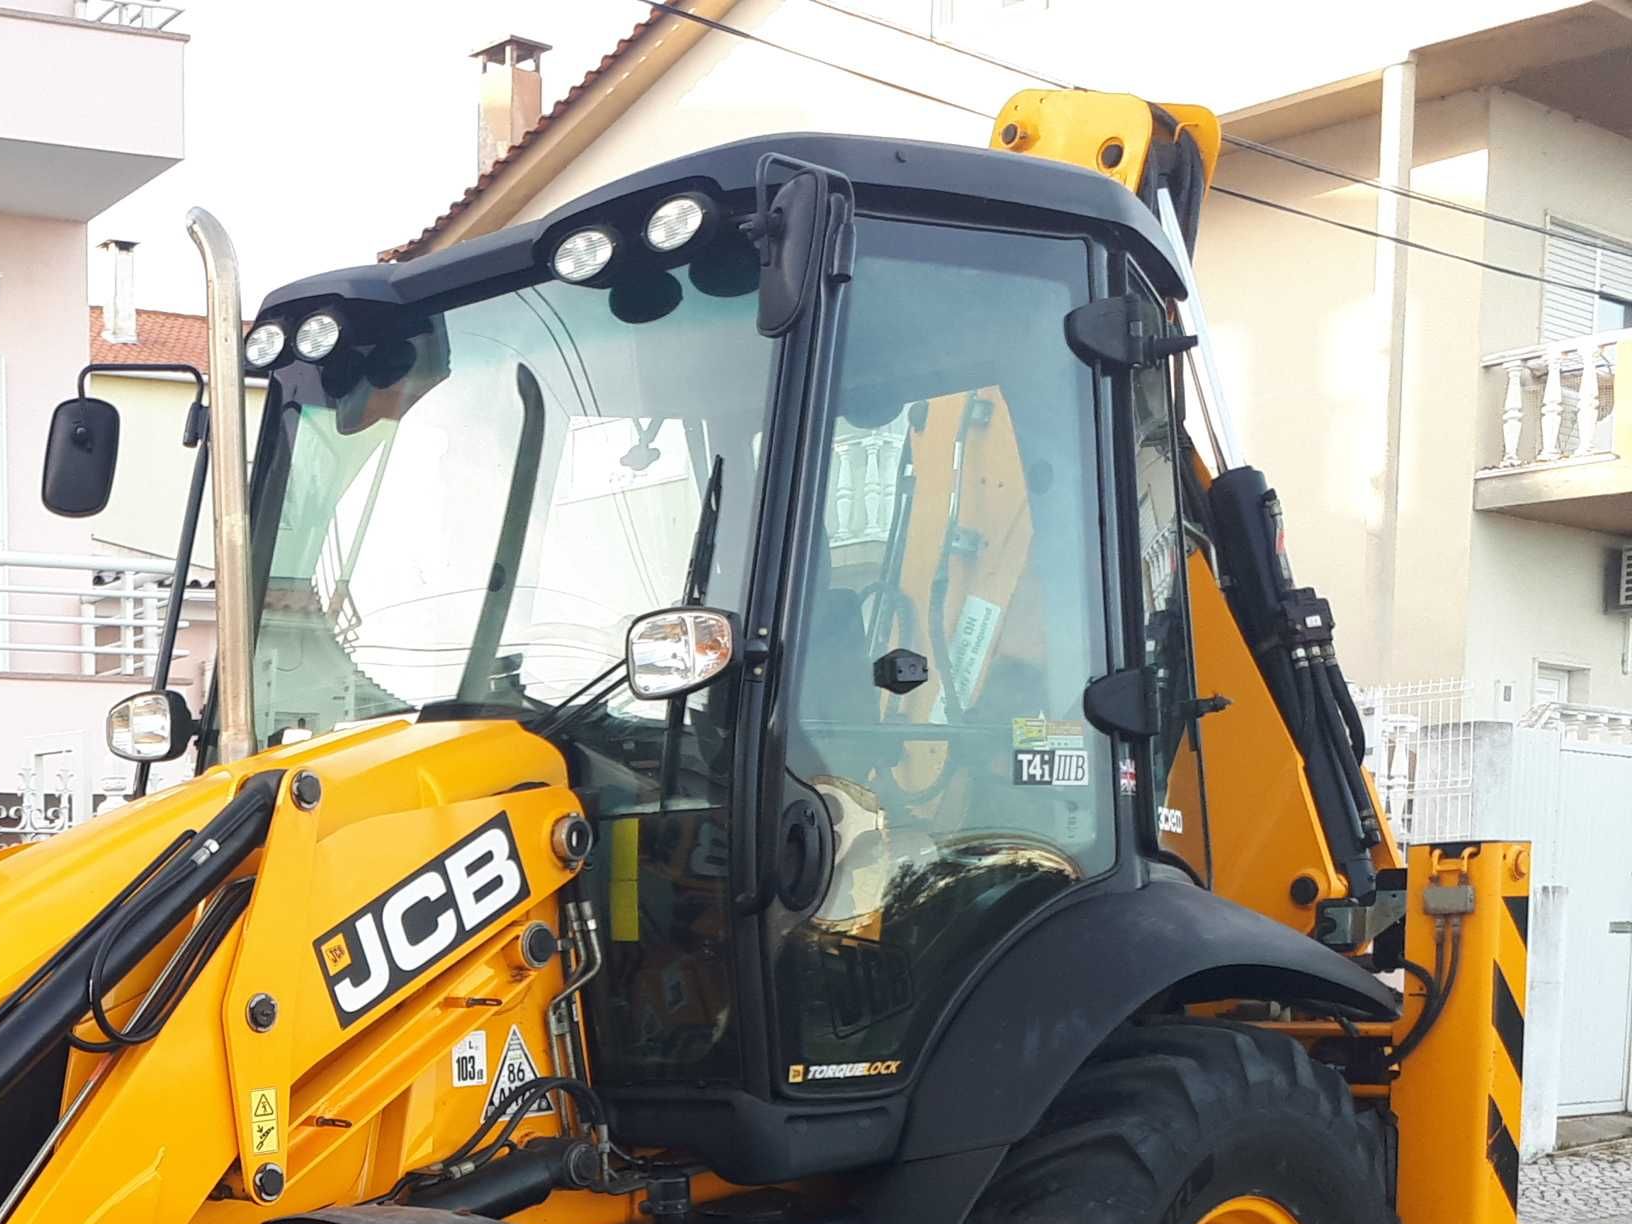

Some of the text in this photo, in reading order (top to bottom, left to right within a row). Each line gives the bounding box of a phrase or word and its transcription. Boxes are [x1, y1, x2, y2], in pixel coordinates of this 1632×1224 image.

[1017, 753, 1051, 782] T4i
[333, 828, 521, 1013] JCB
[455, 1055, 476, 1082] 103
[507, 1062, 526, 1084] 86
[808, 1061, 902, 1080] TORQUELOCK
